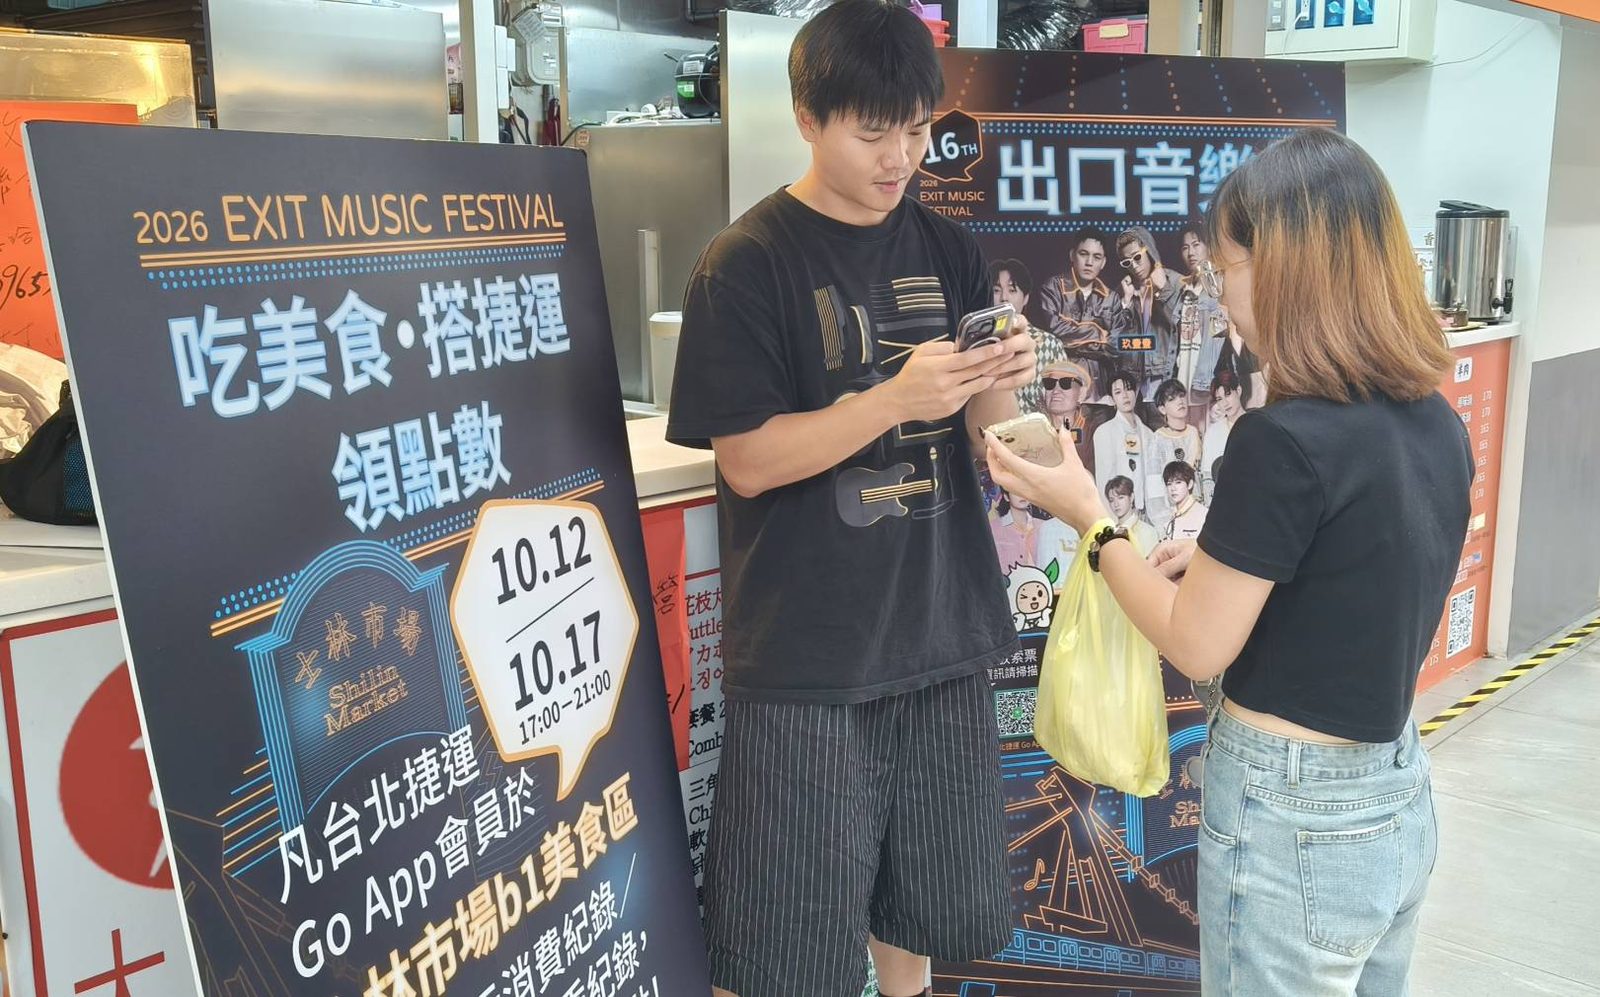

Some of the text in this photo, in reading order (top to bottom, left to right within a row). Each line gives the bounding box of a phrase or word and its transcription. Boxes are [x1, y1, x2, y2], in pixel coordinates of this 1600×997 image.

[133, 193, 565, 244] 2026 EXIT MUSIC FESTIVAL
[920, 191, 985, 201] EXIT MUSIC
[928, 206, 973, 216] STIVAL
[332, 401, 513, 533] 領點數
[492, 516, 592, 605] 10.12
[510, 610, 600, 711] 10.17
[688, 617, 723, 640] uttle
[324, 679, 409, 736] Market
[329, 665, 400, 710] Shilin
[279, 725, 480, 905] 凡台北捷運
[292, 913, 352, 979] Go
[479, 852, 637, 997] 消費紀錄/
[562, 931, 648, 997] 紀錄，
